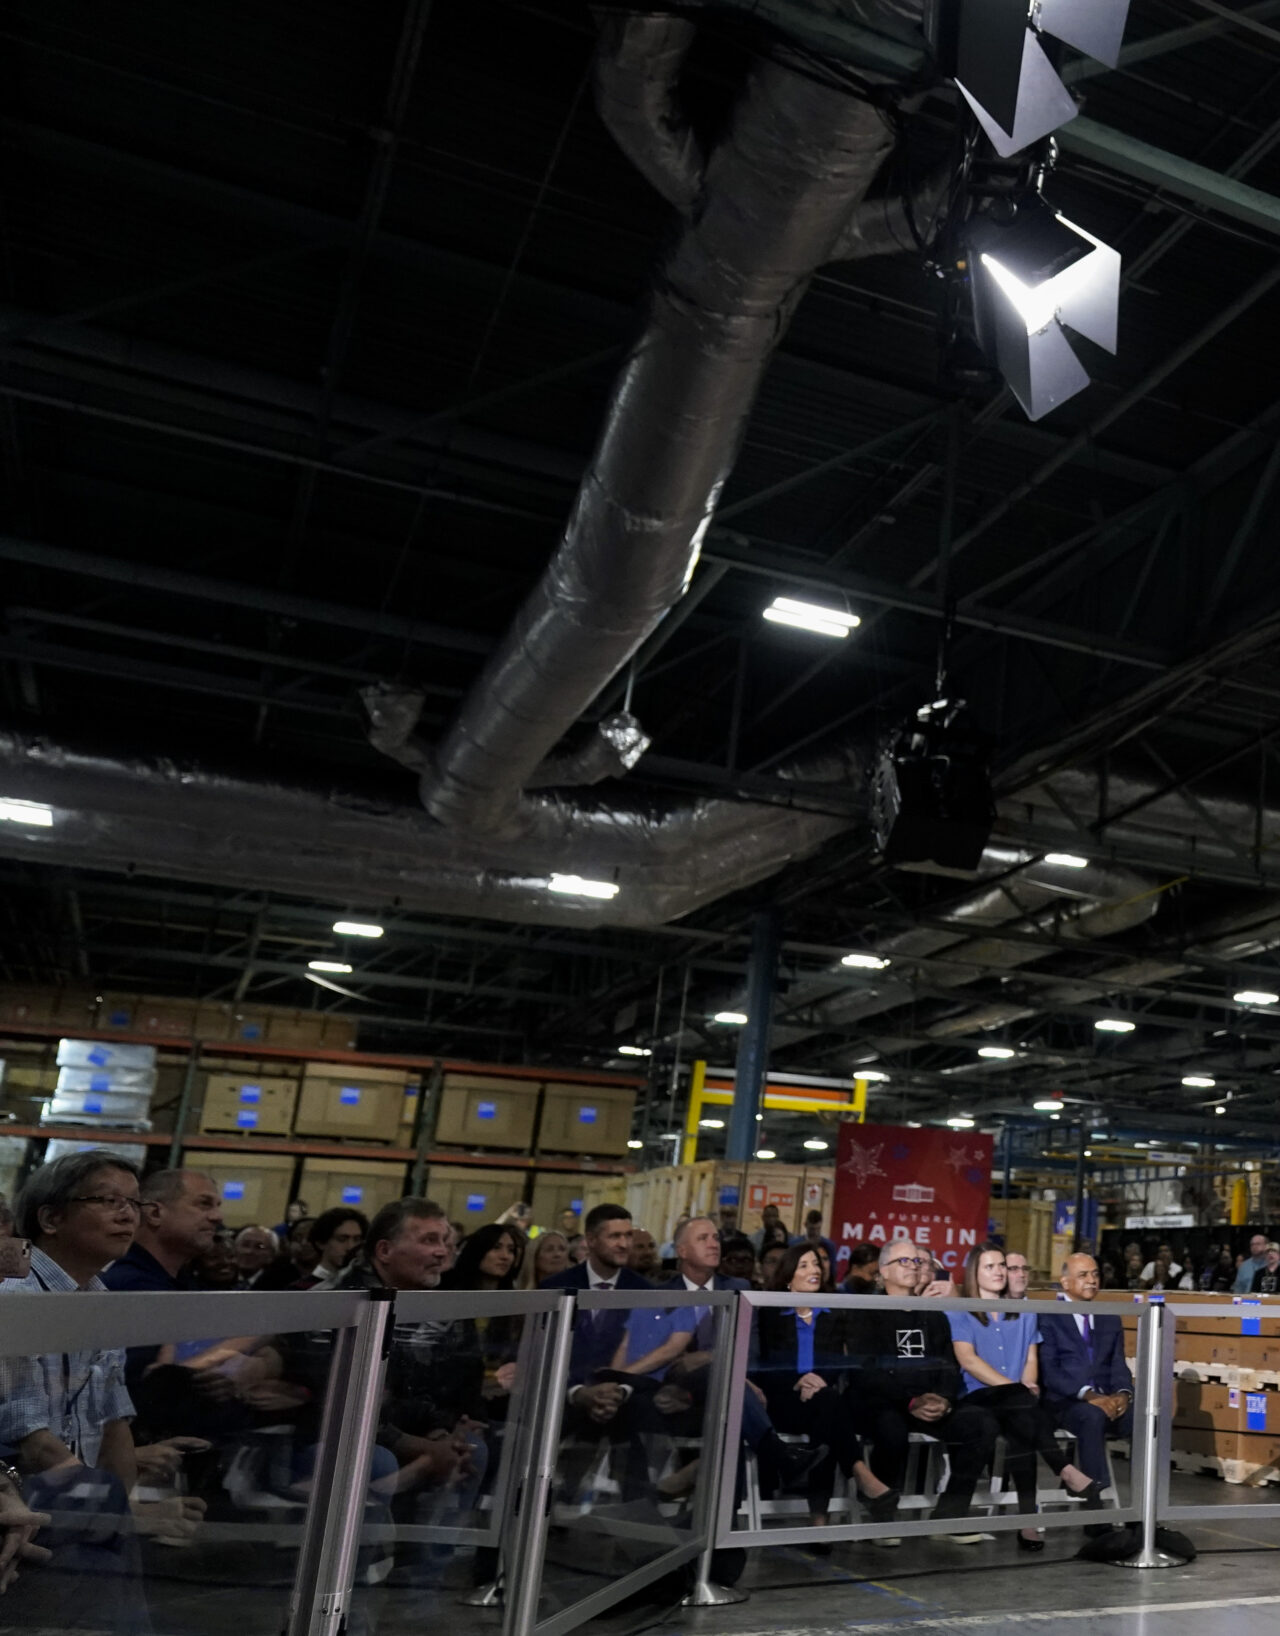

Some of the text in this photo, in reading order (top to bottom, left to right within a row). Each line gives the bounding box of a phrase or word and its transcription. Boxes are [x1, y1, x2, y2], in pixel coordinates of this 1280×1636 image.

[888, 1212, 952, 1224] FUTURE
[842, 1222, 976, 1246] MADE IN
